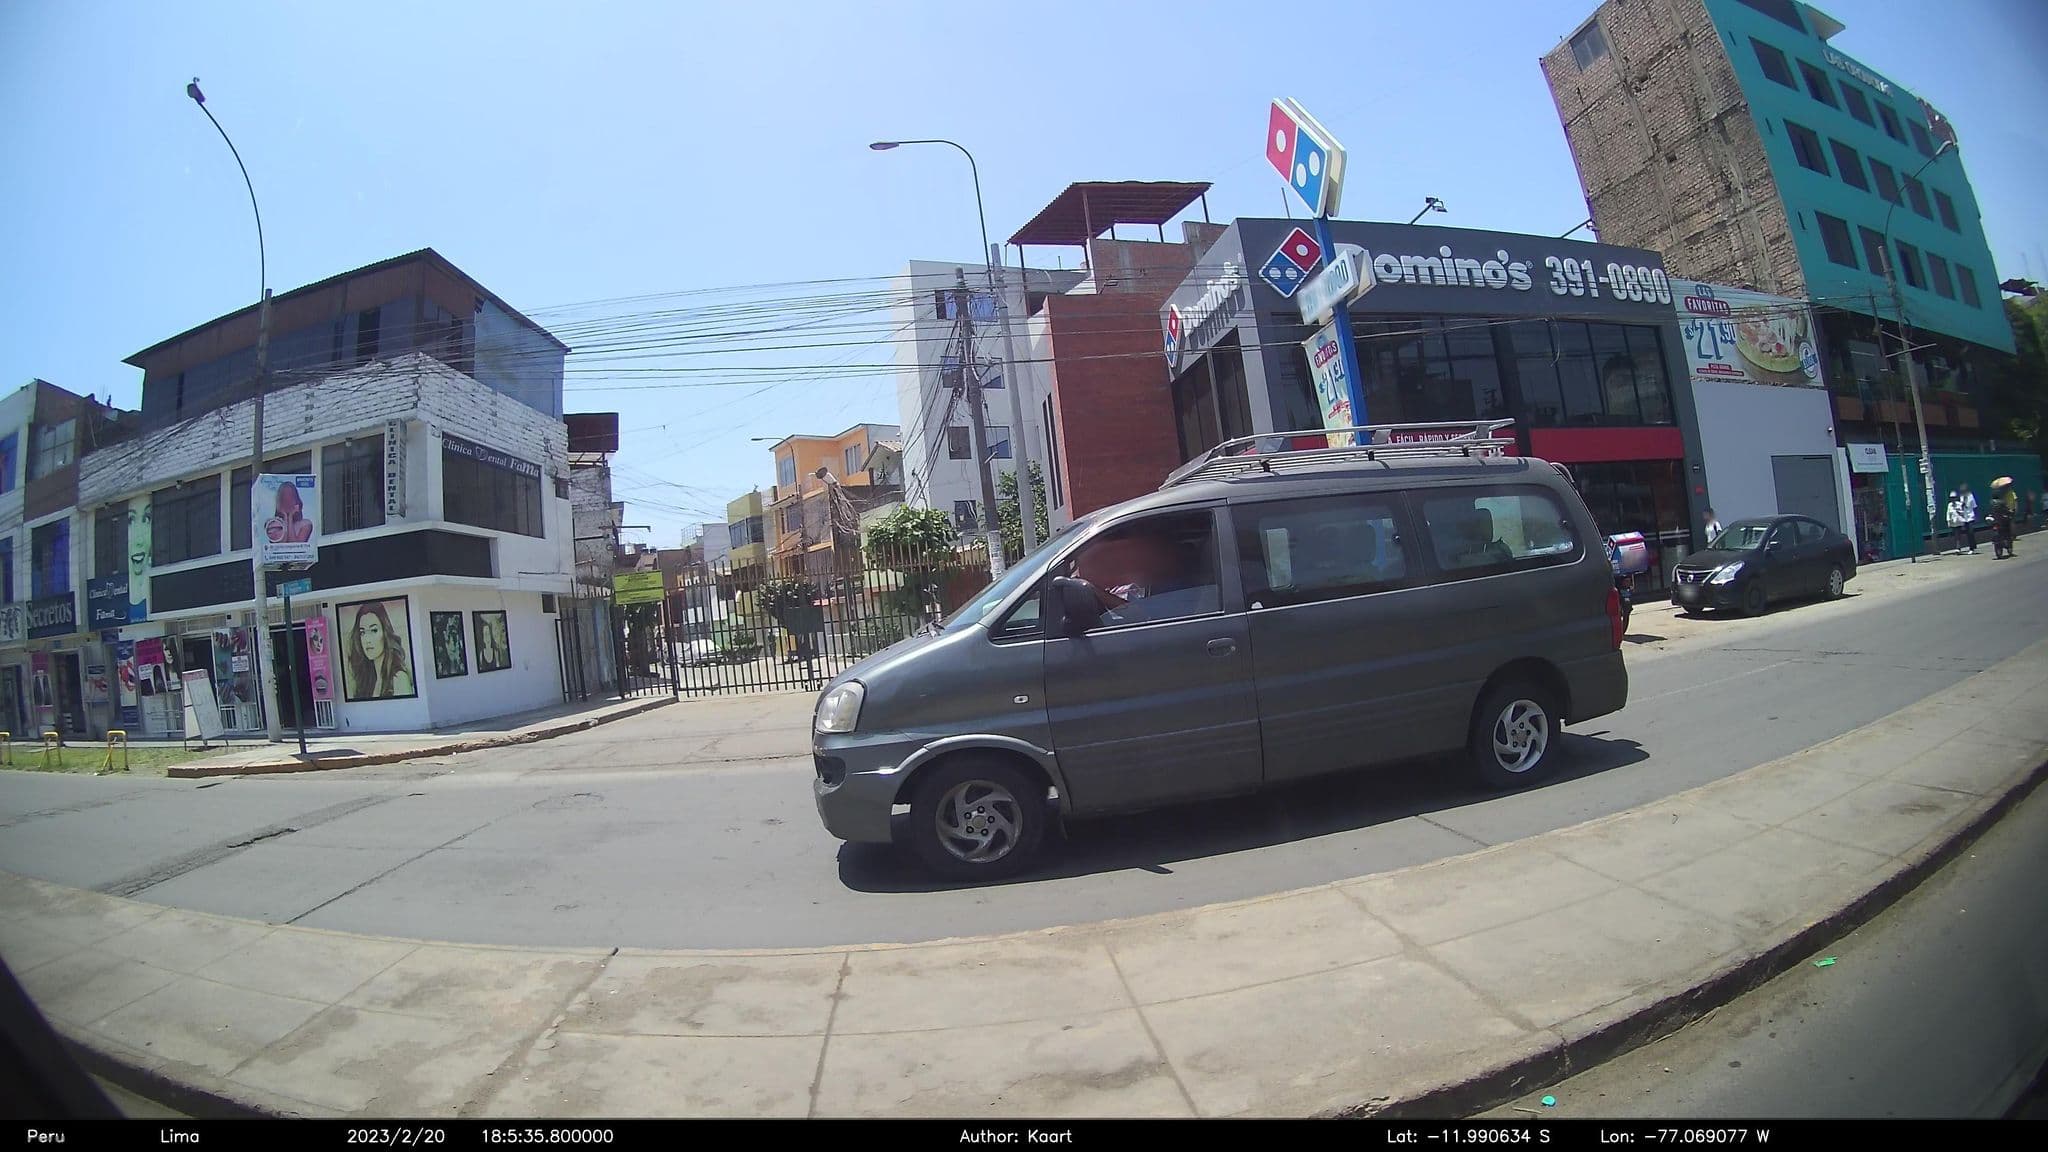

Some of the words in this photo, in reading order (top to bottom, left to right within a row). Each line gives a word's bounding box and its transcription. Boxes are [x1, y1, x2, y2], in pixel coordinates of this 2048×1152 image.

[1333, 244, 1533, 291] omino's
[1545, 256, 1672, 305] 391-0890
[387, 421, 397, 465] CLINICA
[476, 446, 508, 467] Dental
[387, 472, 397, 512] DENTAL
[26, 601, 72, 628] Secretos
